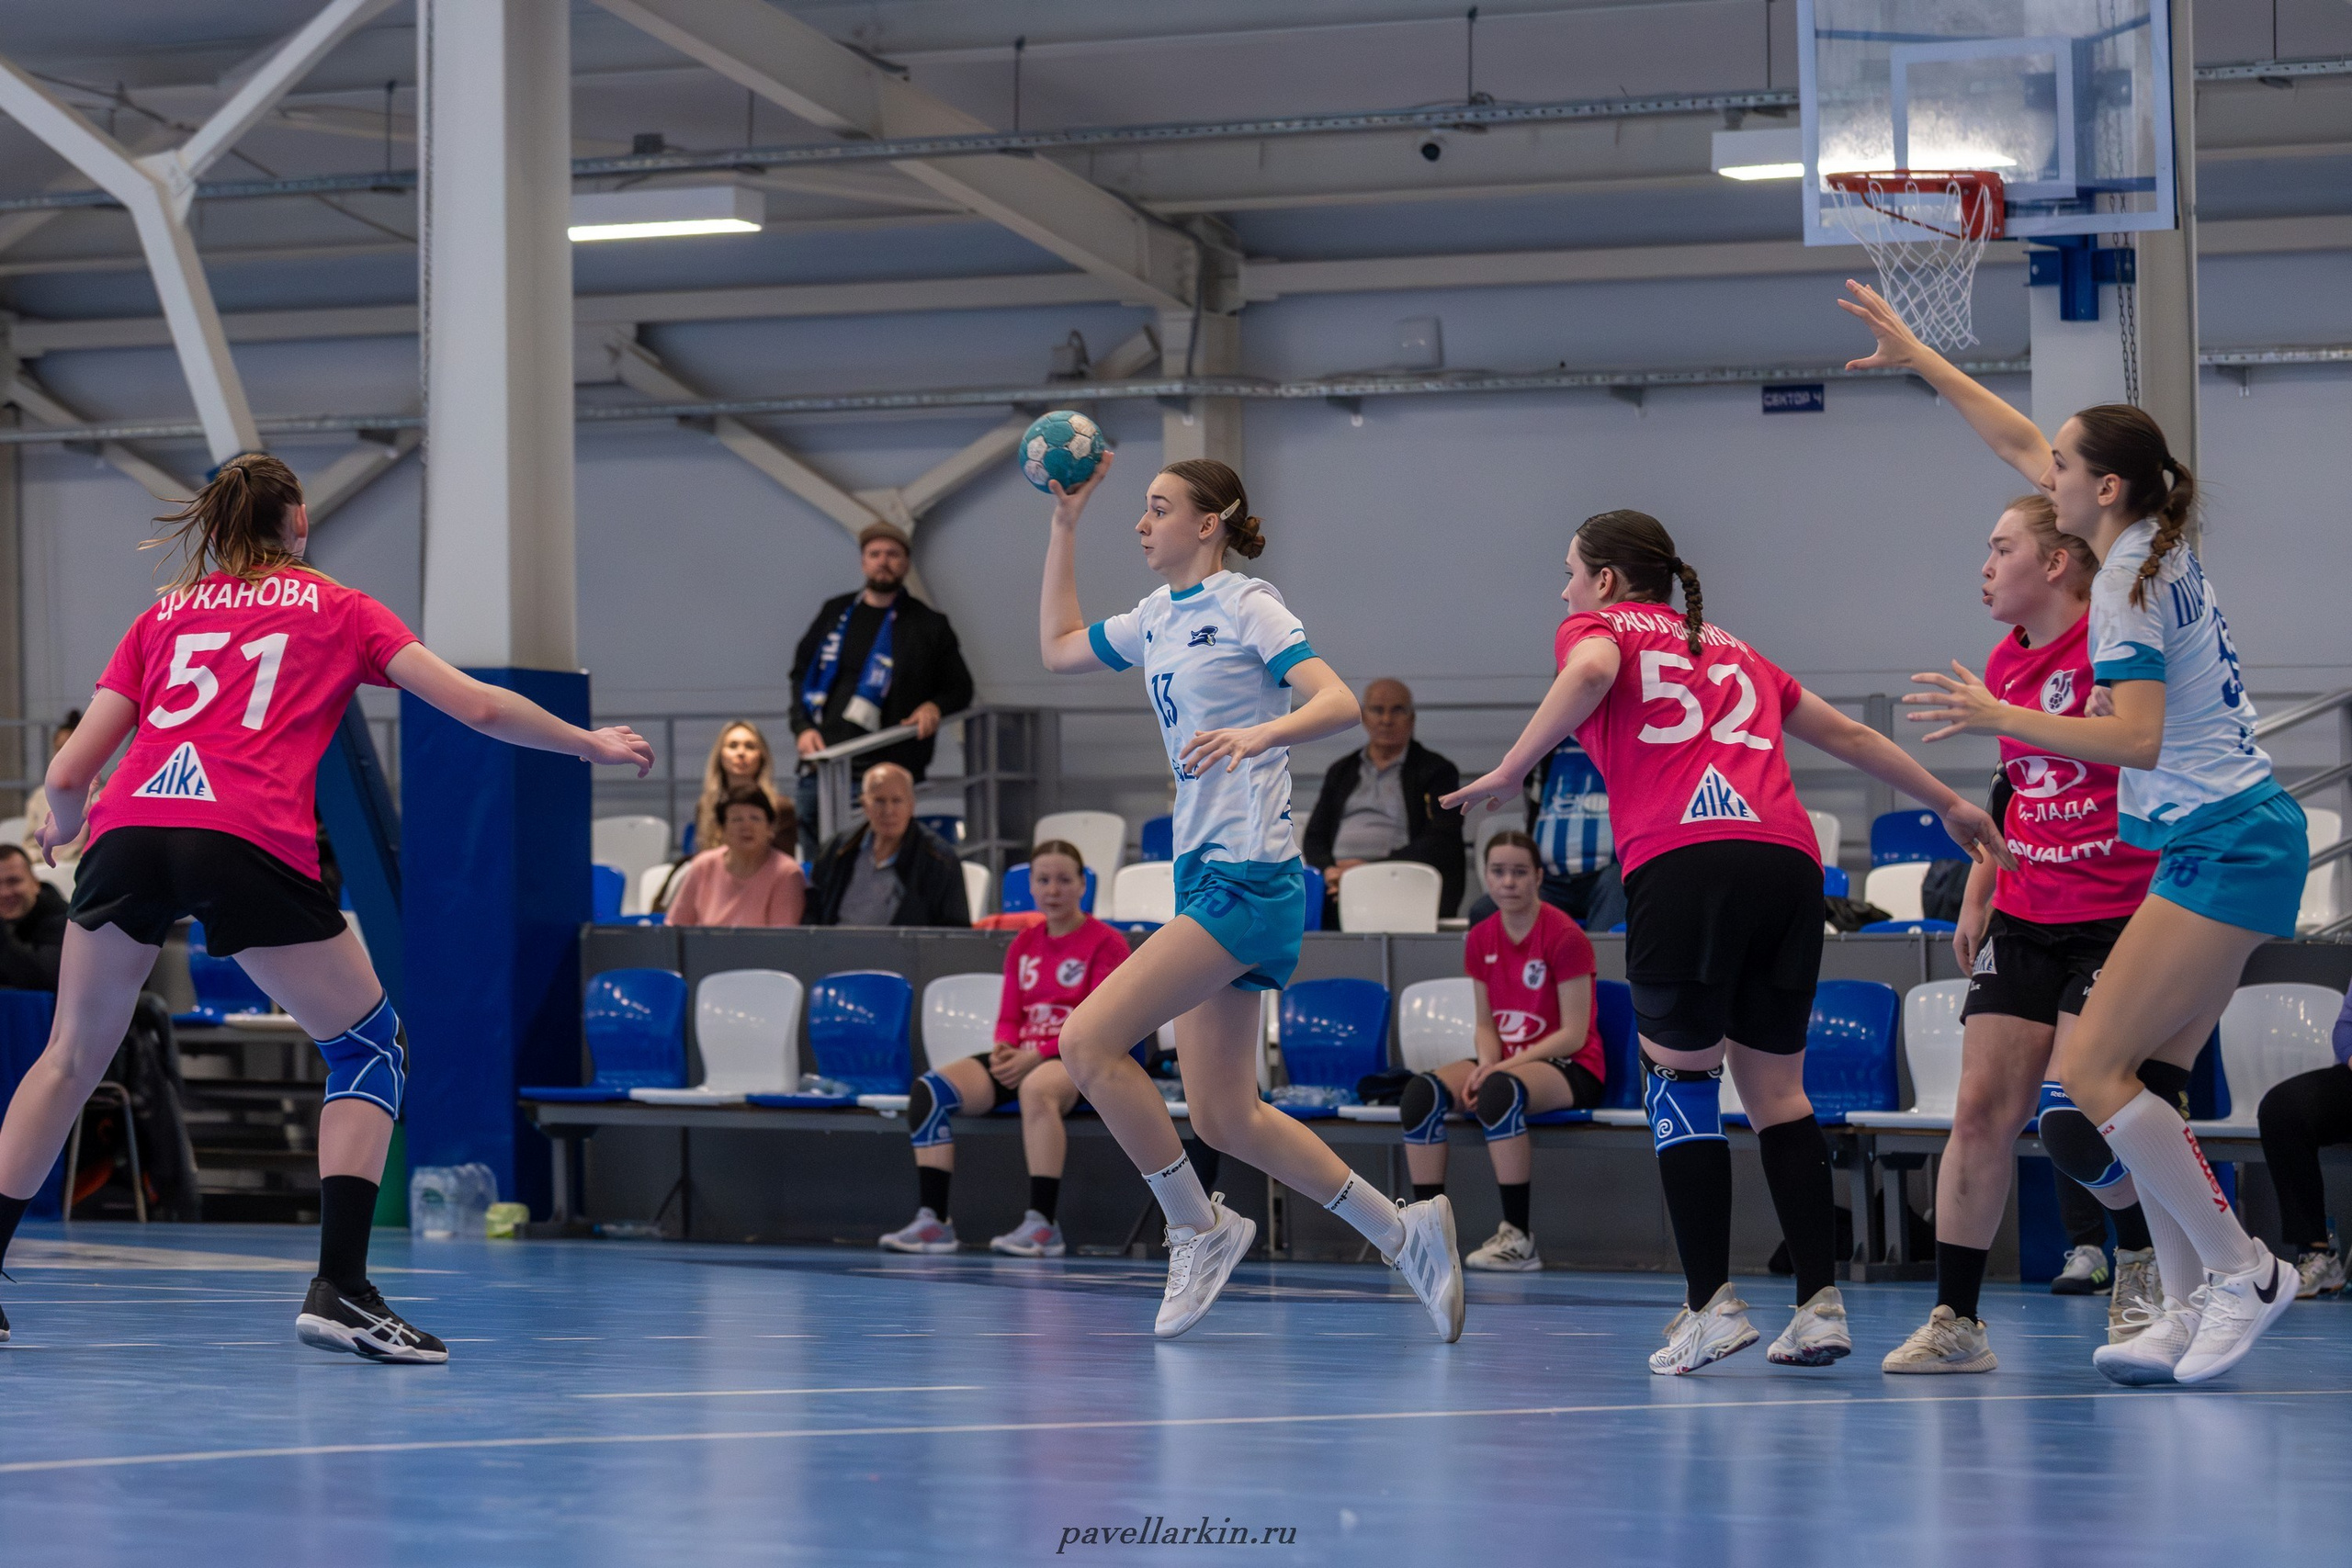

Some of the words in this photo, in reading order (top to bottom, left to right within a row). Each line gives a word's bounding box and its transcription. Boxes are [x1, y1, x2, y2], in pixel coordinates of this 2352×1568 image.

[147, 631, 289, 730] 51
[1151, 672, 1178, 728] 13
[1637, 649, 1773, 750] 52
[1161, 1156, 1189, 1179] Kem
[1328, 1179, 1354, 1212] empa
